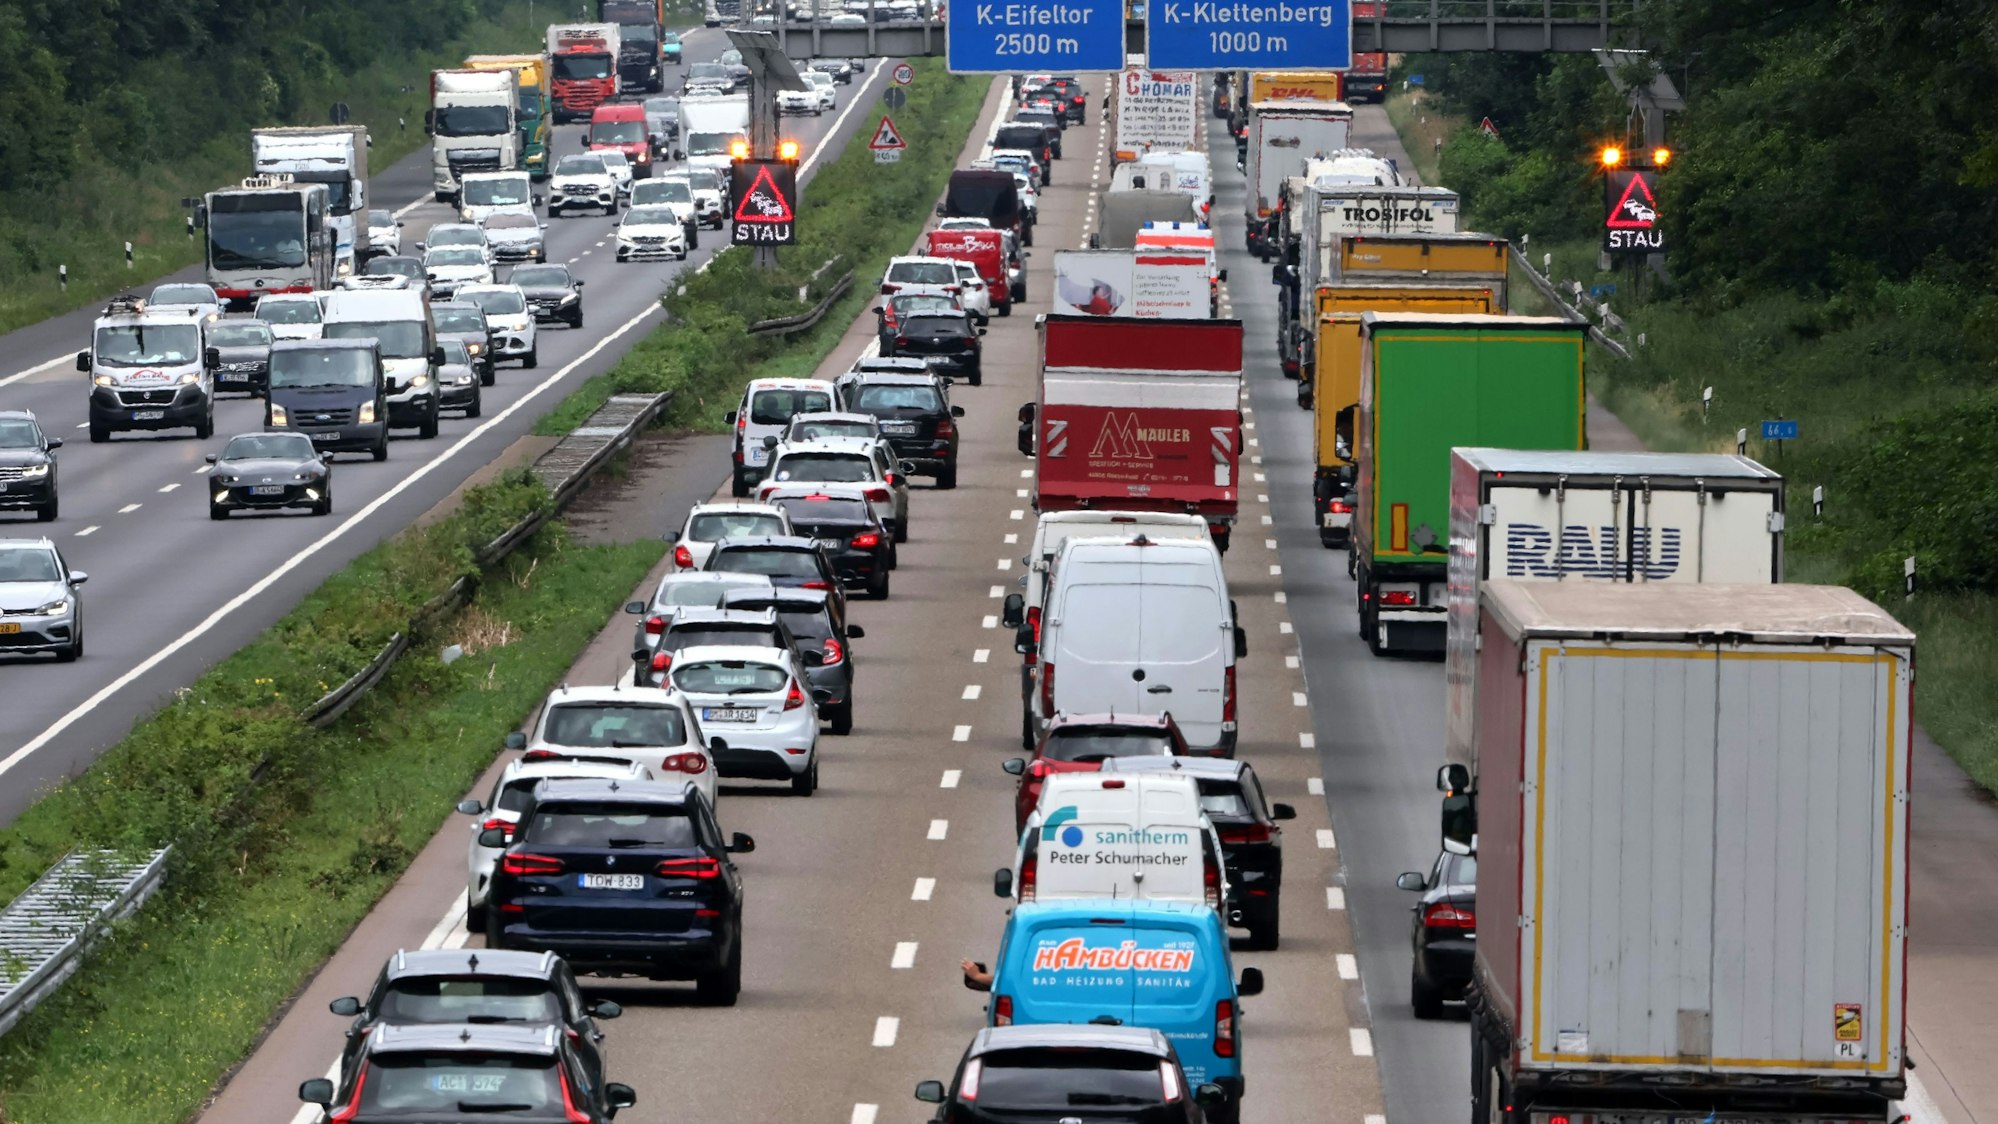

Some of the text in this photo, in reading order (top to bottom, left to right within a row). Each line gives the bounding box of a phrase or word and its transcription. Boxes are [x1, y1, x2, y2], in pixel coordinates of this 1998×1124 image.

[976, 4, 1094, 26] K-Eifeltor
[1164, 3, 1333, 27] K-Klettenberg
[995, 34, 1079, 55] 2500 m
[1209, 32, 1288, 53] 1000 m
[1271, 87, 1315, 98] DHL
[1343, 207, 1434, 222] TROSIFOL
[736, 223, 790, 241] STAU
[1609, 229, 1663, 248] STAU
[1095, 828, 1188, 845] sanitherm
[1050, 851, 1188, 866] Peter Schumacher
[1032, 937, 1194, 972] HAMBÜCKEN
[1033, 976, 1057, 986] BAD
[1840, 1043, 1854, 1056] PL
